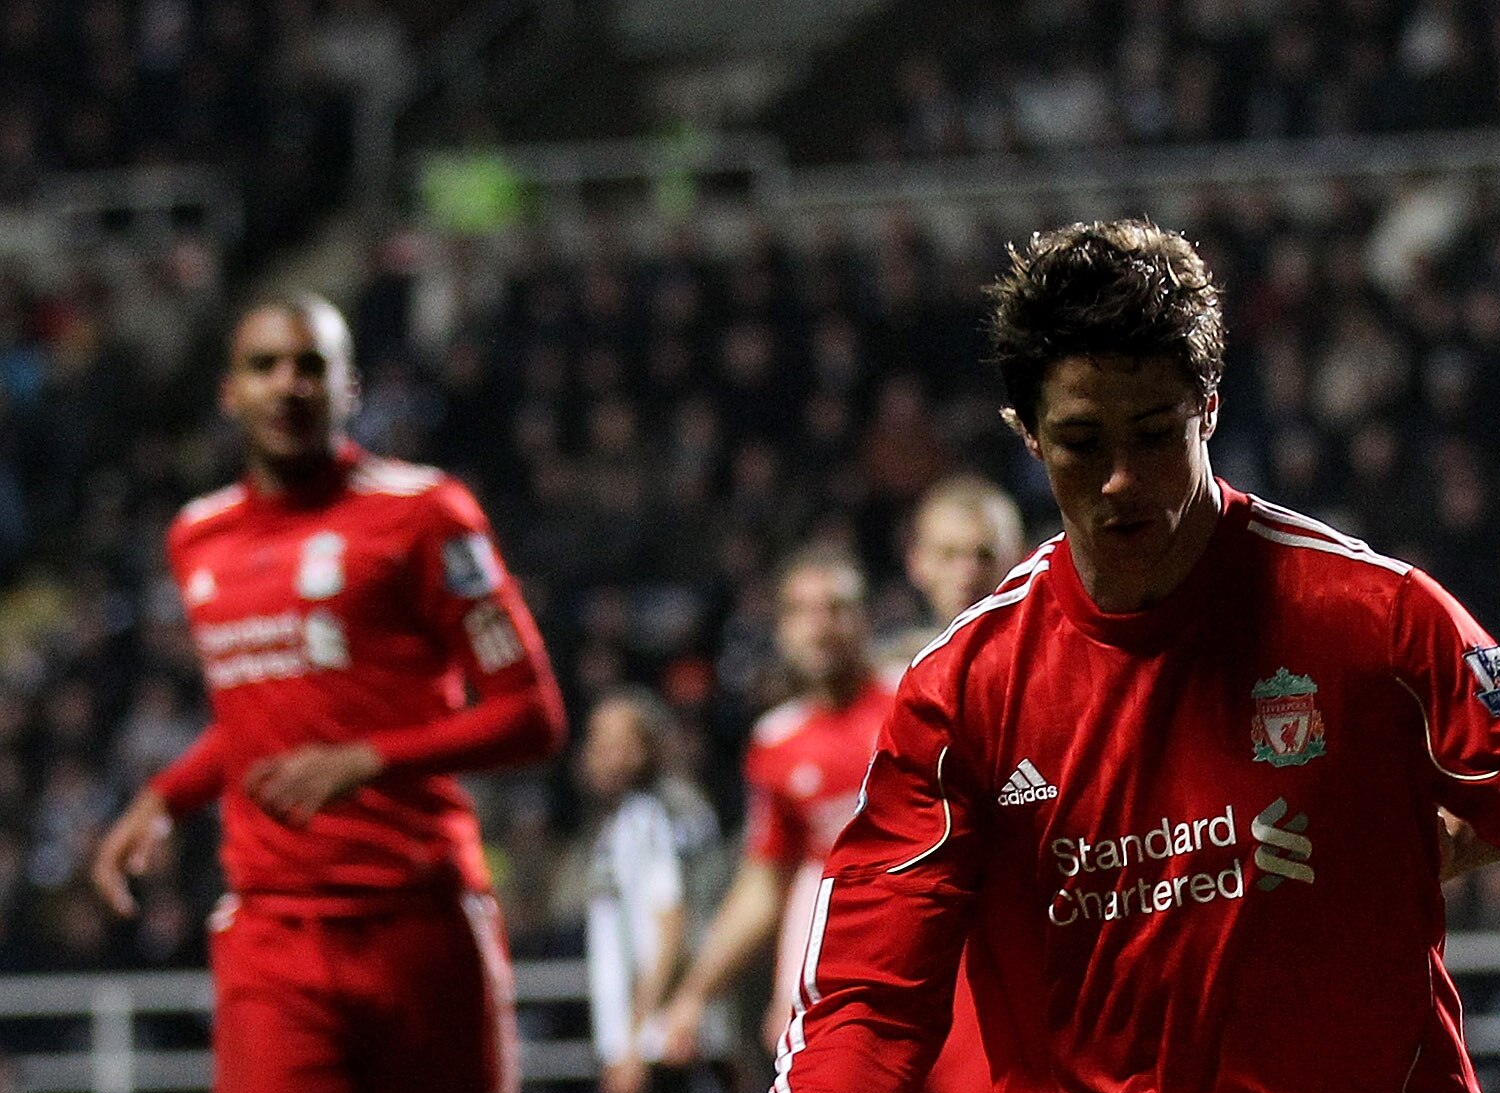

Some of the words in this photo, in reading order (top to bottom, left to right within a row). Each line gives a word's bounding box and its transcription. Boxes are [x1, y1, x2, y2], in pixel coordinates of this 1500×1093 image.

[997, 784, 1058, 806] adidas
[1051, 805, 1237, 878] Standard
[1048, 858, 1245, 926] Chartered
